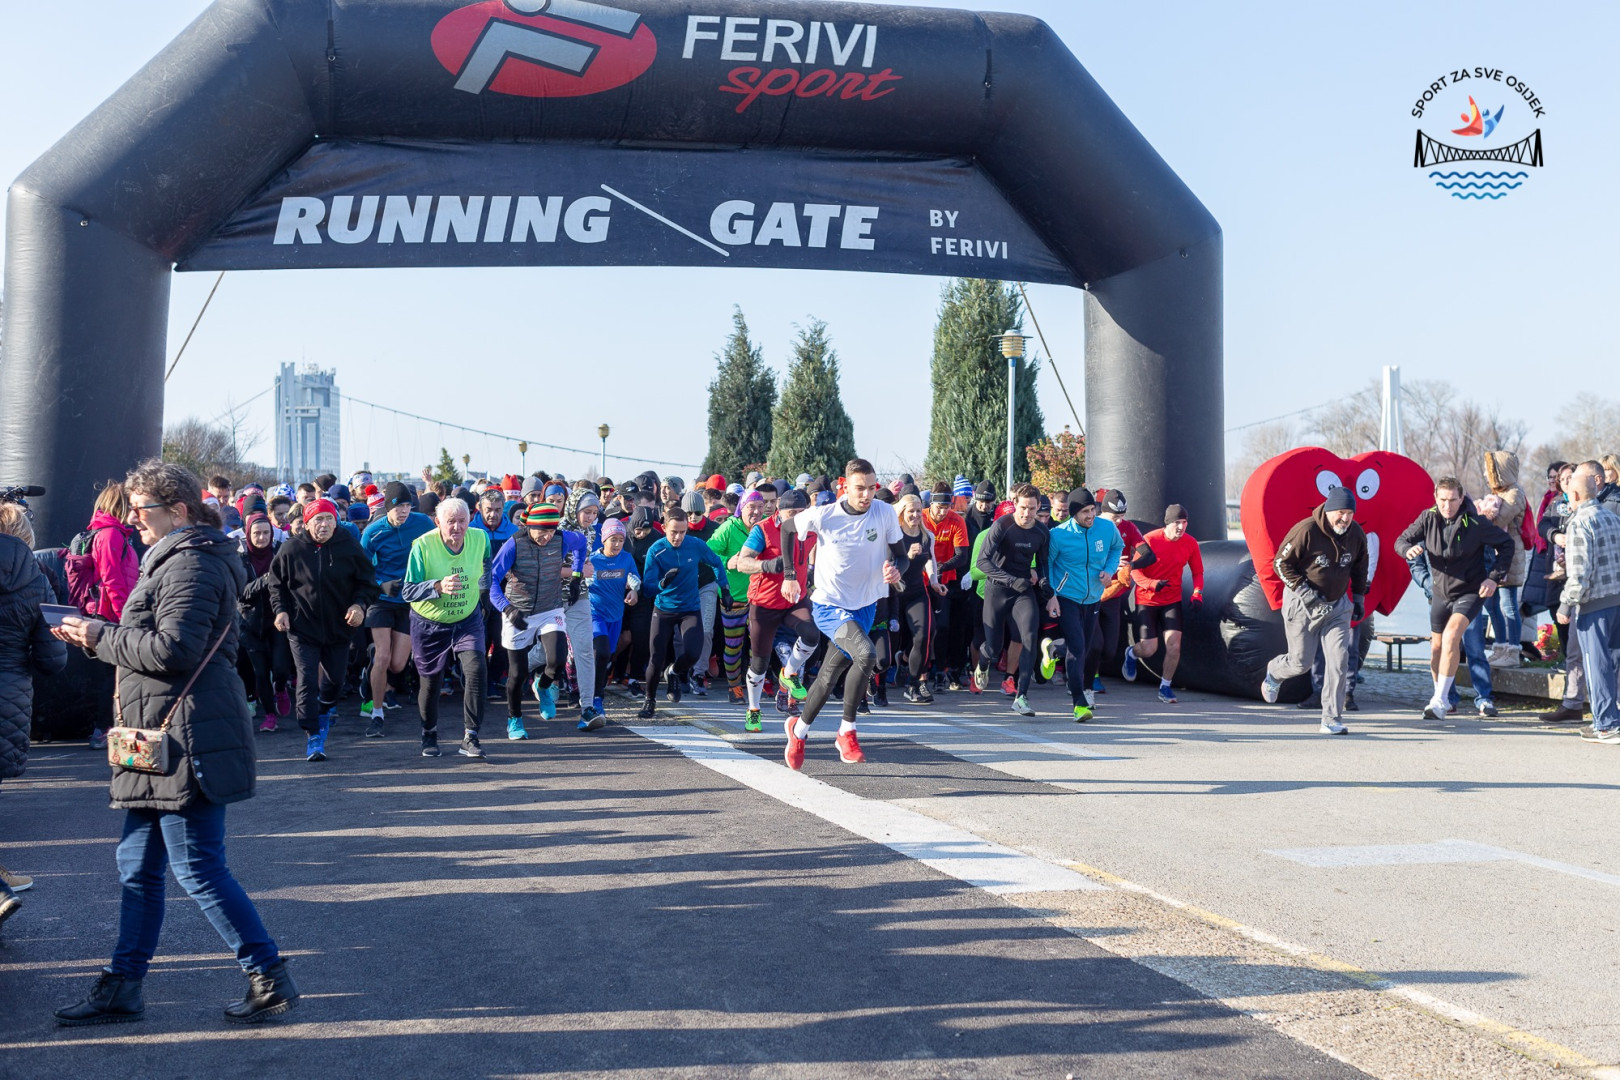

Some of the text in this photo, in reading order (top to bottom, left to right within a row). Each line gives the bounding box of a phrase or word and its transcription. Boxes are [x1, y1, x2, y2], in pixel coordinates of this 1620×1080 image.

[682, 15, 878, 67] FERIVI
[718, 66, 904, 114] sport
[273, 195, 880, 250] RUNNING GATE
[929, 209, 959, 228] BY
[931, 237, 1008, 260] FERIVI
